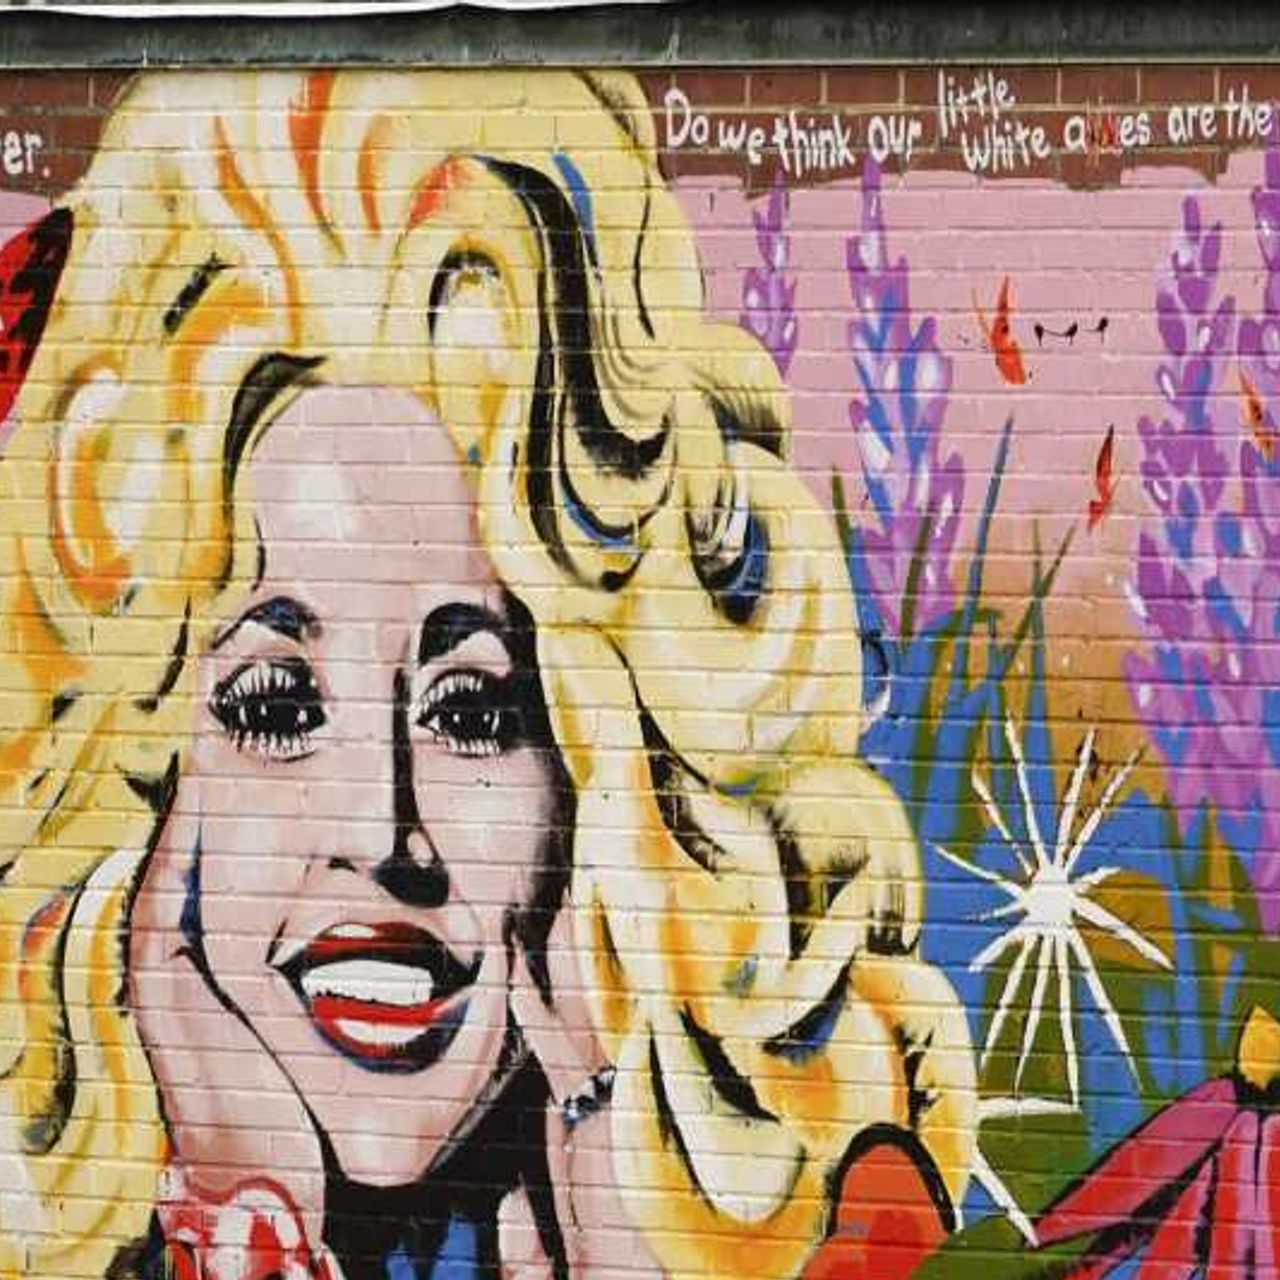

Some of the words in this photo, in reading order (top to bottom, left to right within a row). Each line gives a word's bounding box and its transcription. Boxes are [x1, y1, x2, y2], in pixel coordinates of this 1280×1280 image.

[664, 88, 709, 147] Do
[719, 119, 767, 164] we
[772, 110, 856, 178] think
[868, 115, 922, 163] our
[937, 67, 1016, 138] little
[1168, 103, 1217, 144] are
[1225, 82, 1272, 138] the
